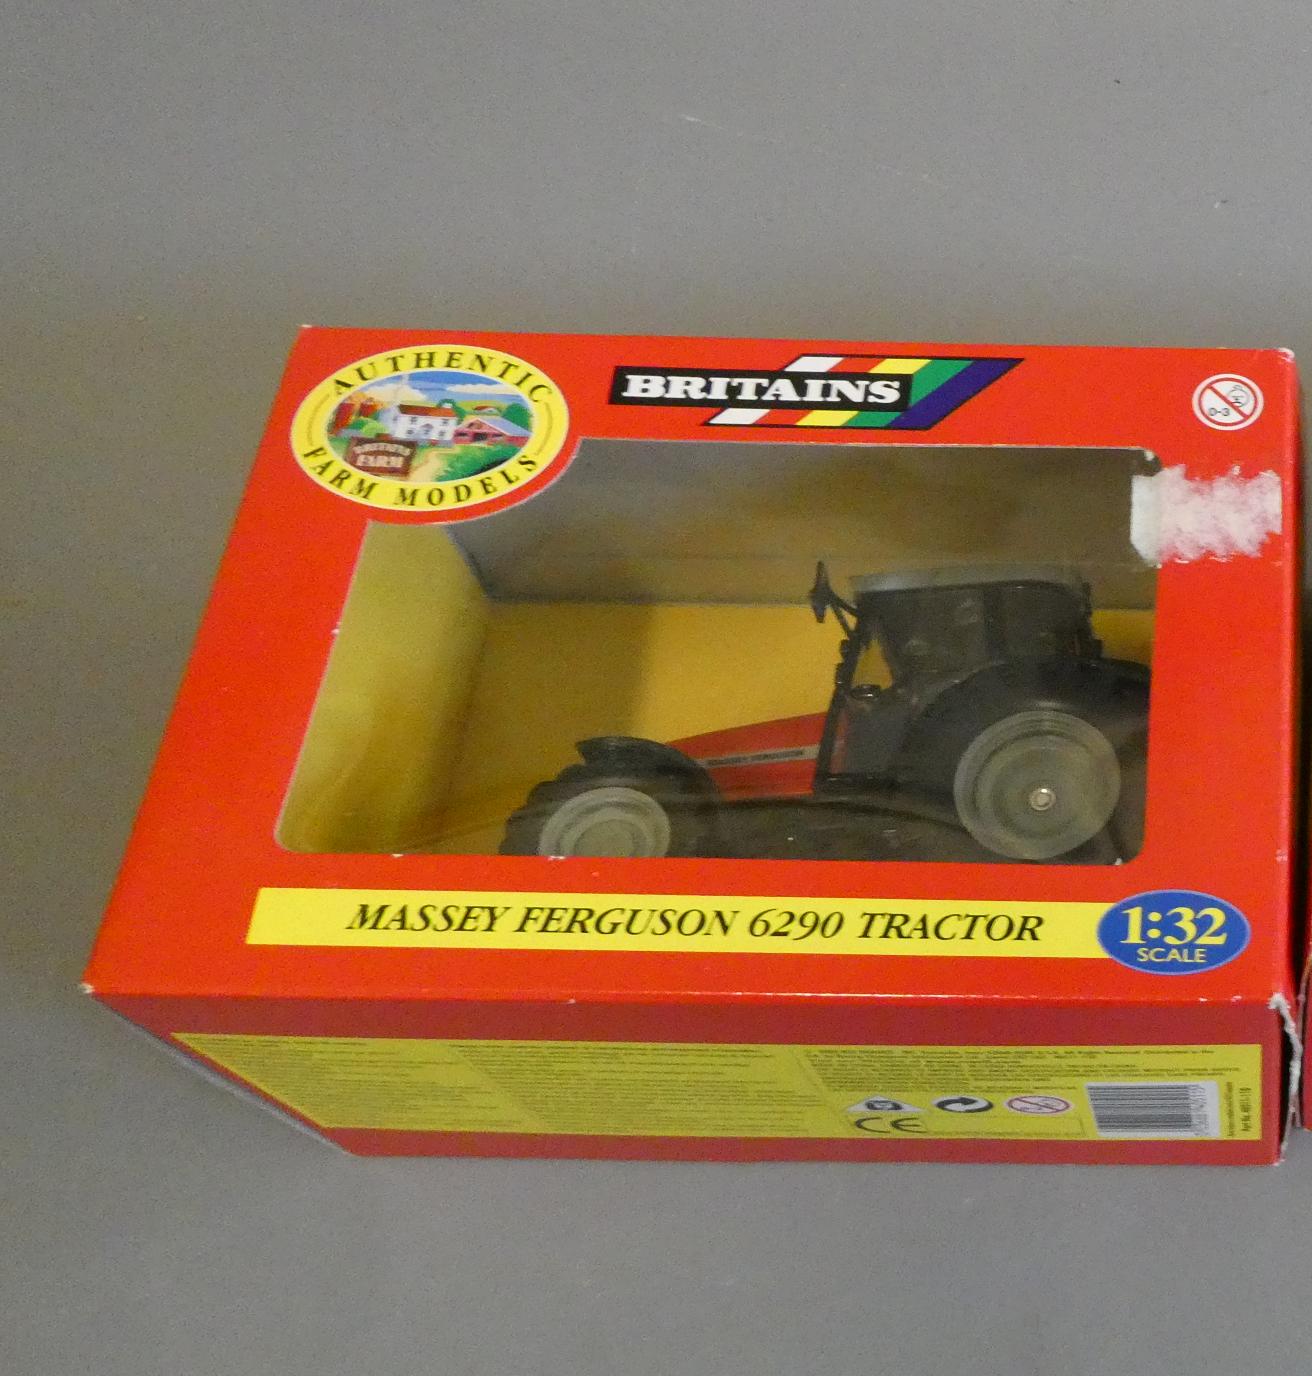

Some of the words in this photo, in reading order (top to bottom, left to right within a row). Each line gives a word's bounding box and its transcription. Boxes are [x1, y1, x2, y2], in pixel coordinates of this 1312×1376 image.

[333, 351, 552, 403] AUTHENTIC
[621, 374, 901, 404] BRITAINS
[303, 446, 379, 500] FARM
[393, 455, 539, 507] MODELS
[346, 903, 511, 932] MASSEY
[513, 906, 737, 938] FERGUSON
[748, 908, 845, 940] 6290
[856, 911, 1045, 943] TRACTOR
[1120, 906, 1228, 947] 1:32
[1136, 947, 1208, 964] SCALE
